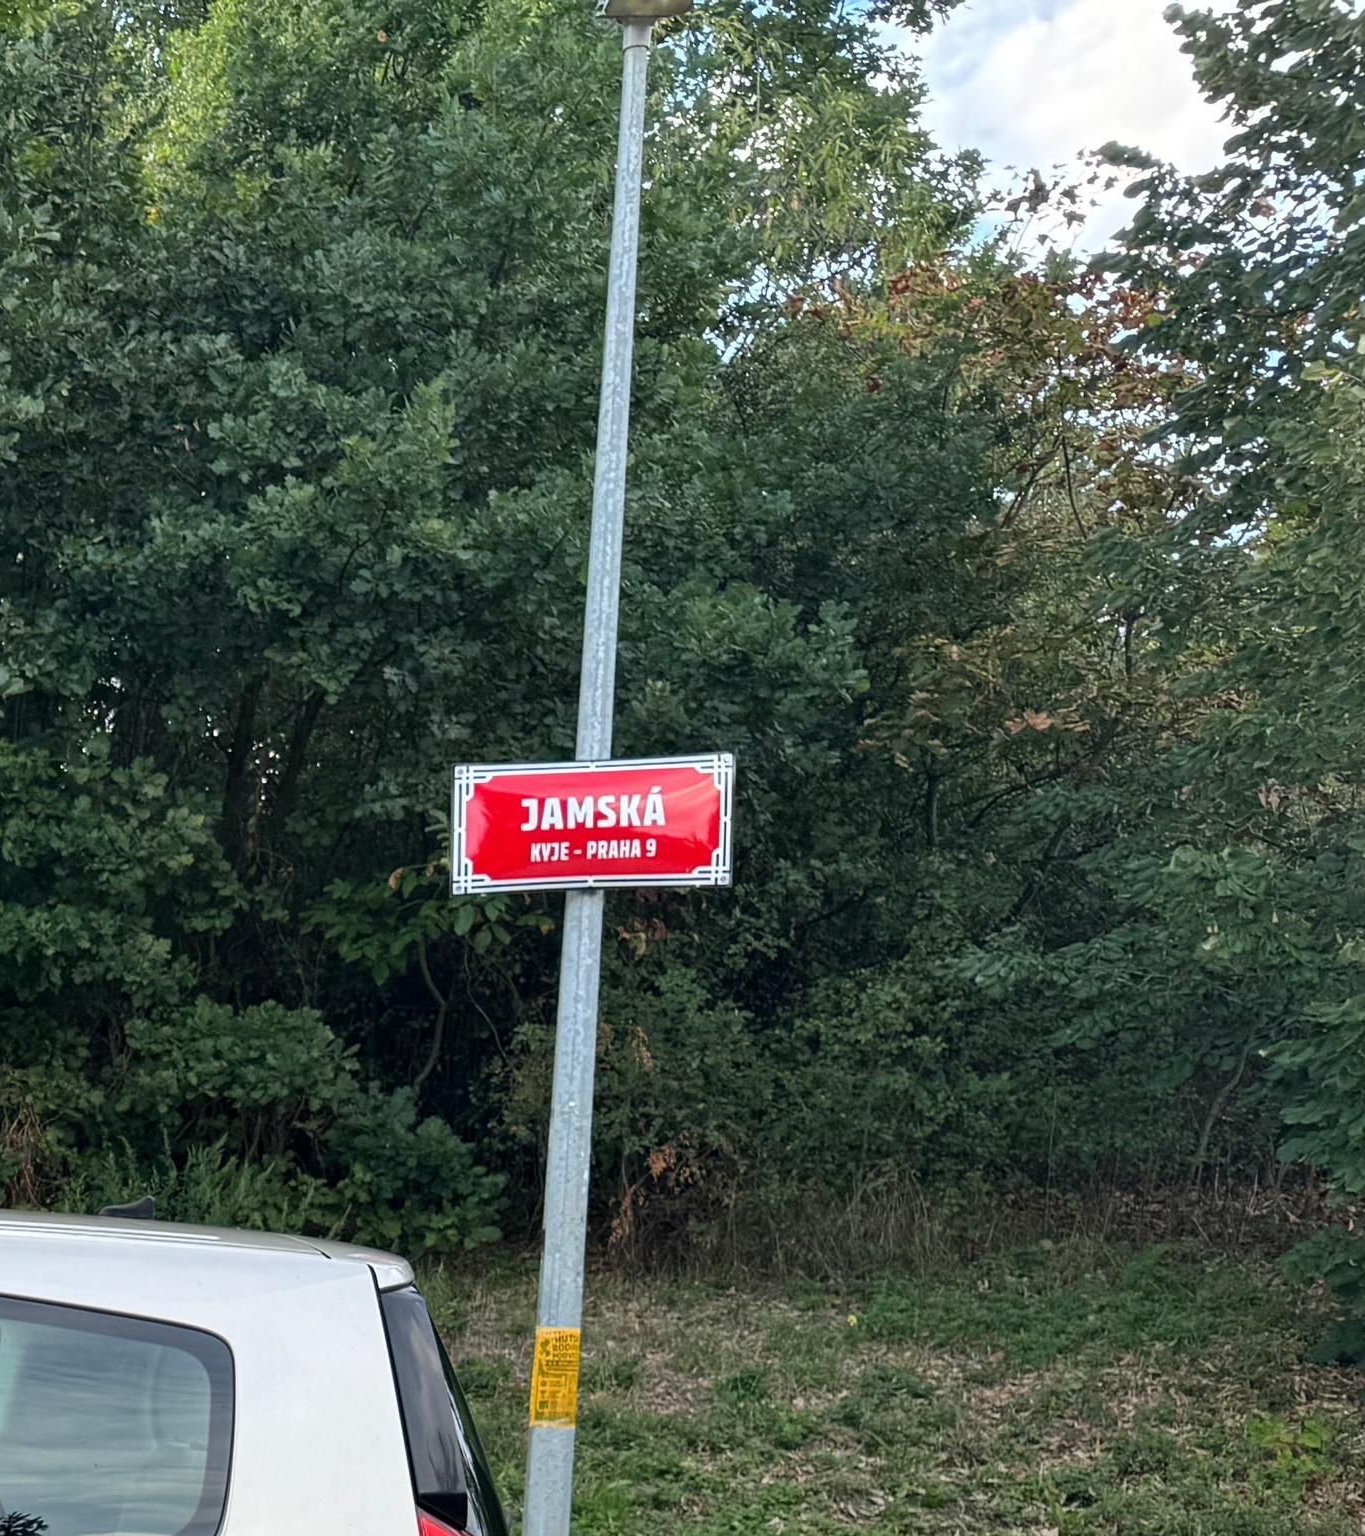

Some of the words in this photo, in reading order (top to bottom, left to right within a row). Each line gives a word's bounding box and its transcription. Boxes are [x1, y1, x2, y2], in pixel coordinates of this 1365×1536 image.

[520, 786, 666, 832] JAMSKÁ
[530, 841, 571, 863] KYJE
[586, 838, 642, 860] PRAHA
[645, 837, 657, 858] 9
